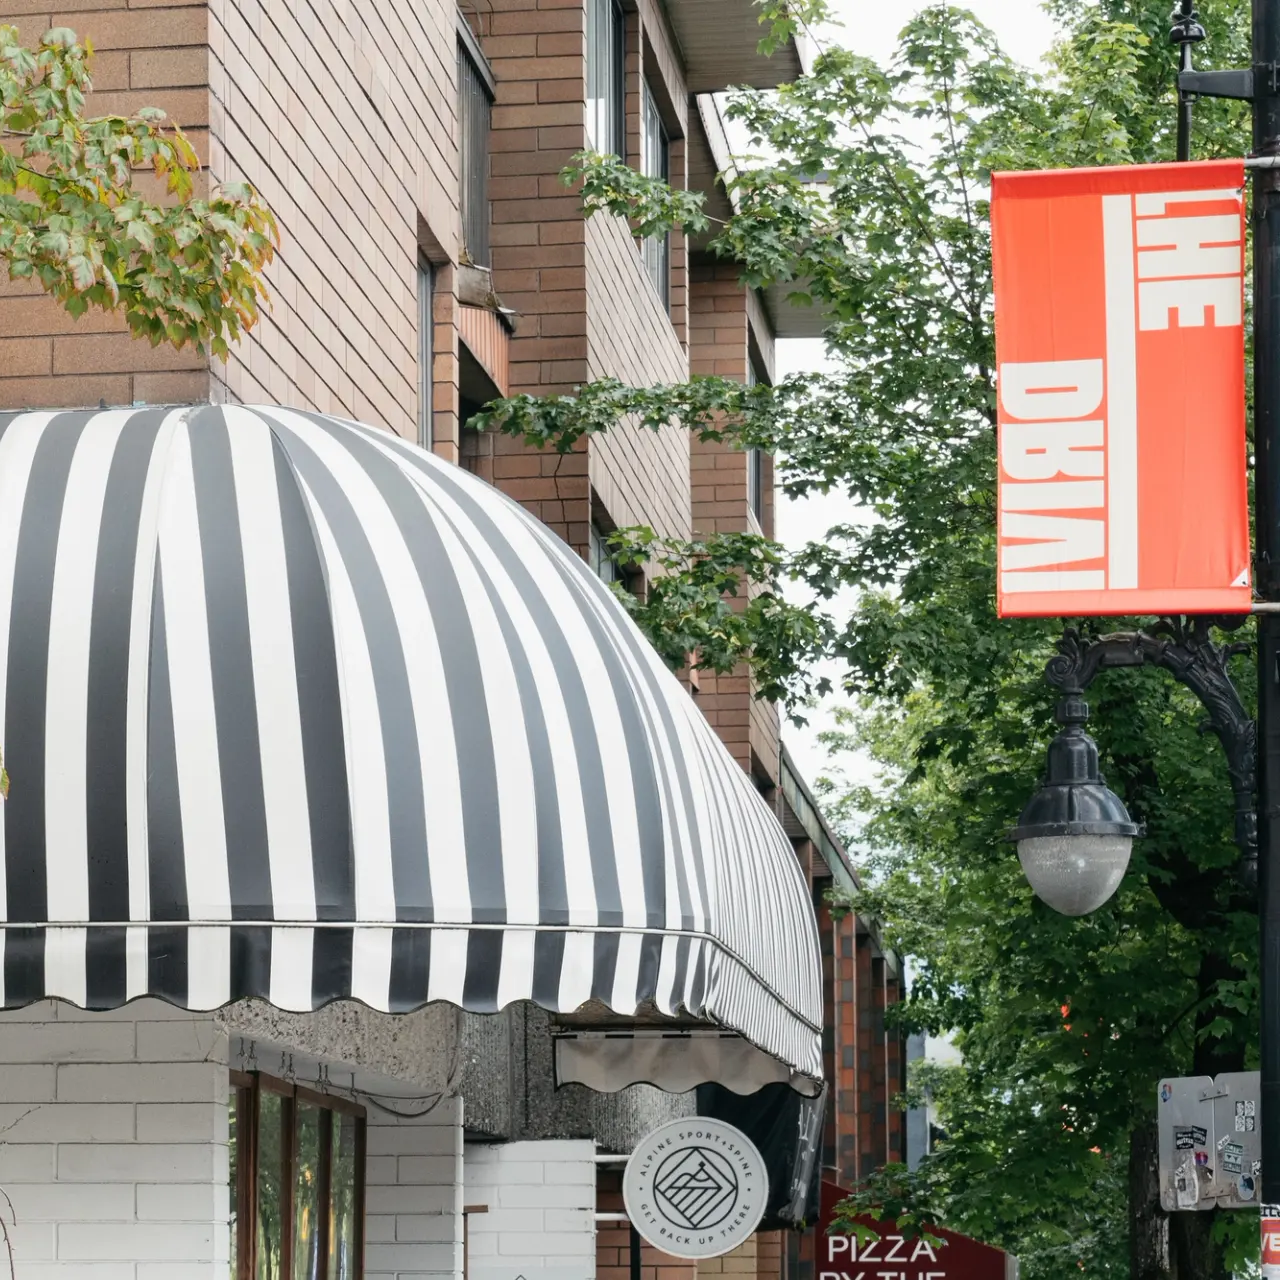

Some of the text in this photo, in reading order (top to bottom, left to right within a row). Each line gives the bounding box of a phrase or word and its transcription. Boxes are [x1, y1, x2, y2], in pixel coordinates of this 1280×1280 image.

[640, 1138, 672, 1177] ALPINE
[640, 1203, 751, 1245] GET BACK UP THERE
[828, 1235, 937, 1262] PIZZA
